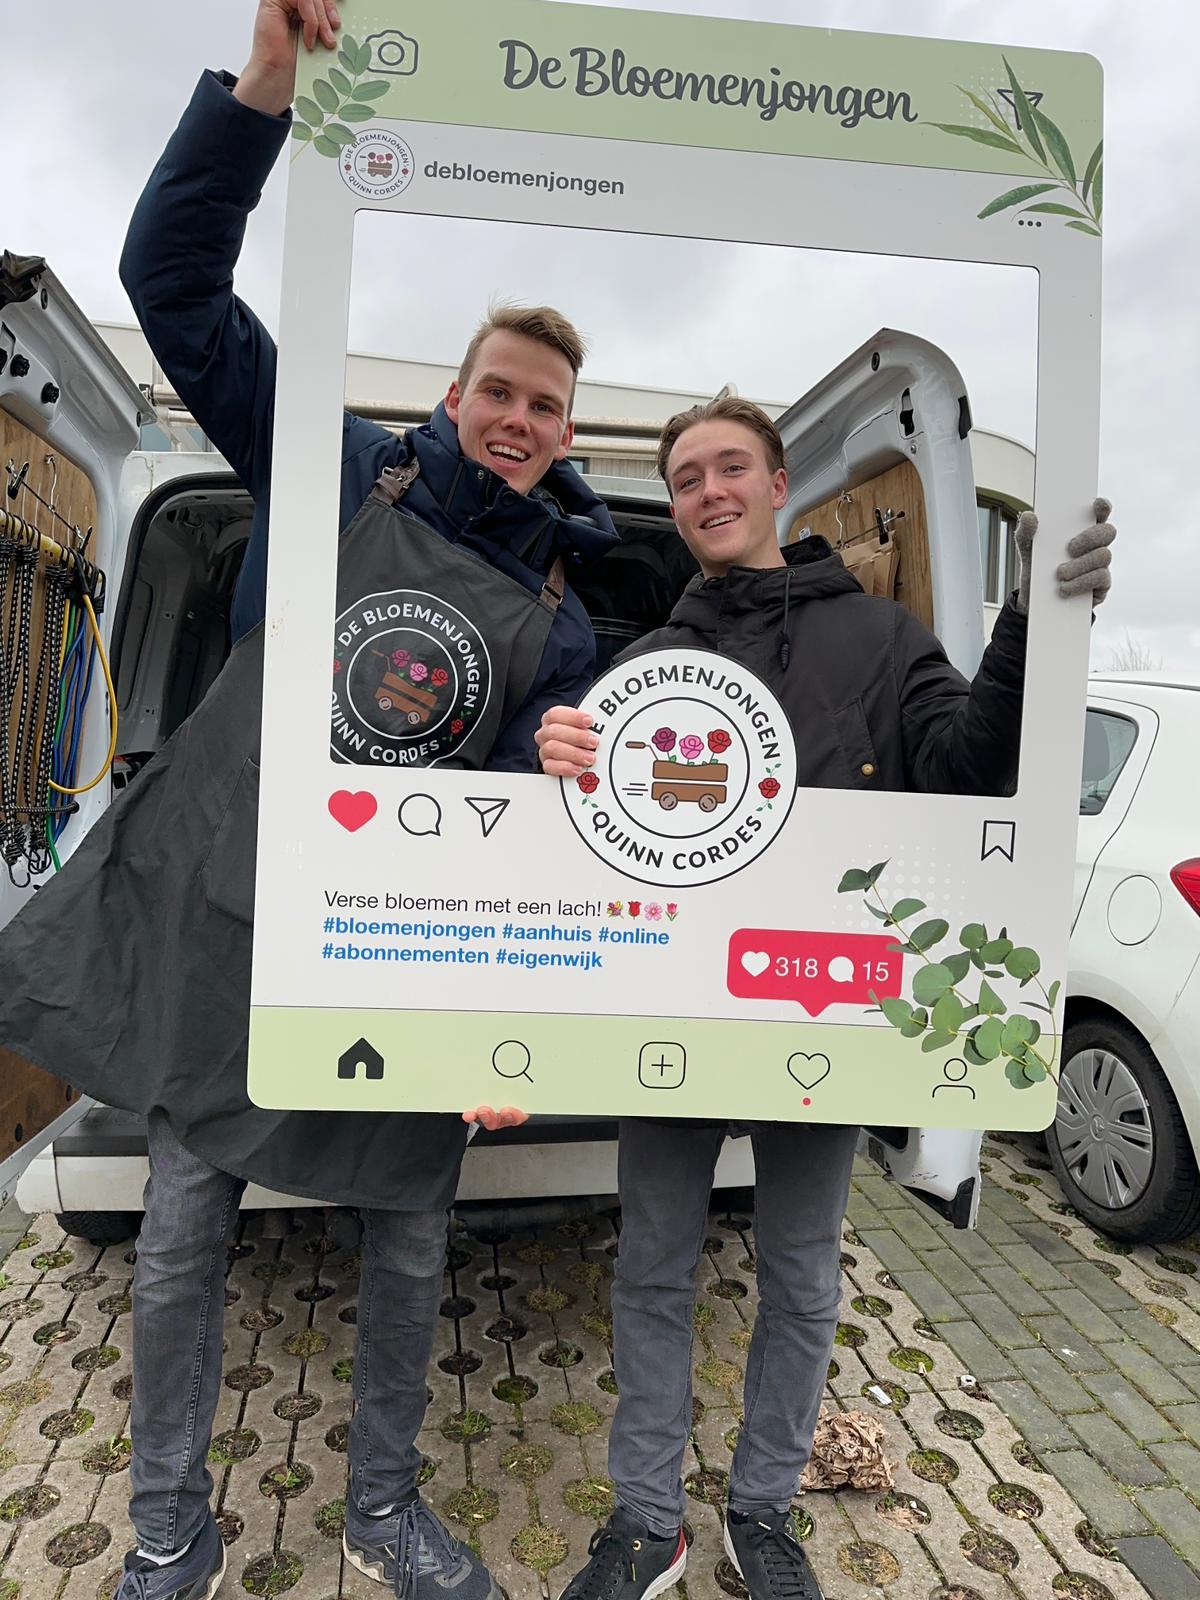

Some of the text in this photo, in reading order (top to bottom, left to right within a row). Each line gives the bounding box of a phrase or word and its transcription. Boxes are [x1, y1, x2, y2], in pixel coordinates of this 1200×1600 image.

[499, 39, 918, 128] De Bloemenjongen
[352, 134, 409, 164] BLOEMENJONGEN
[349, 175, 403, 195] QUINN CORDES
[424, 161, 624, 196] debloemenjongen
[338, 603, 480, 708] DE BLOEMENJONGEN
[598, 665, 781, 760] BLOEMENJONGEN
[369, 739, 440, 764] CORDES
[591, 811, 763, 870] QUINN CORDES
[324, 891, 601, 918] Verse bloemen met een lach!
[323, 917, 670, 945] #bloemenjongen #aanhuis #online
[322, 944, 603, 970] #abonnementen #eigenwijk
[775, 957, 890, 982] 318 15
